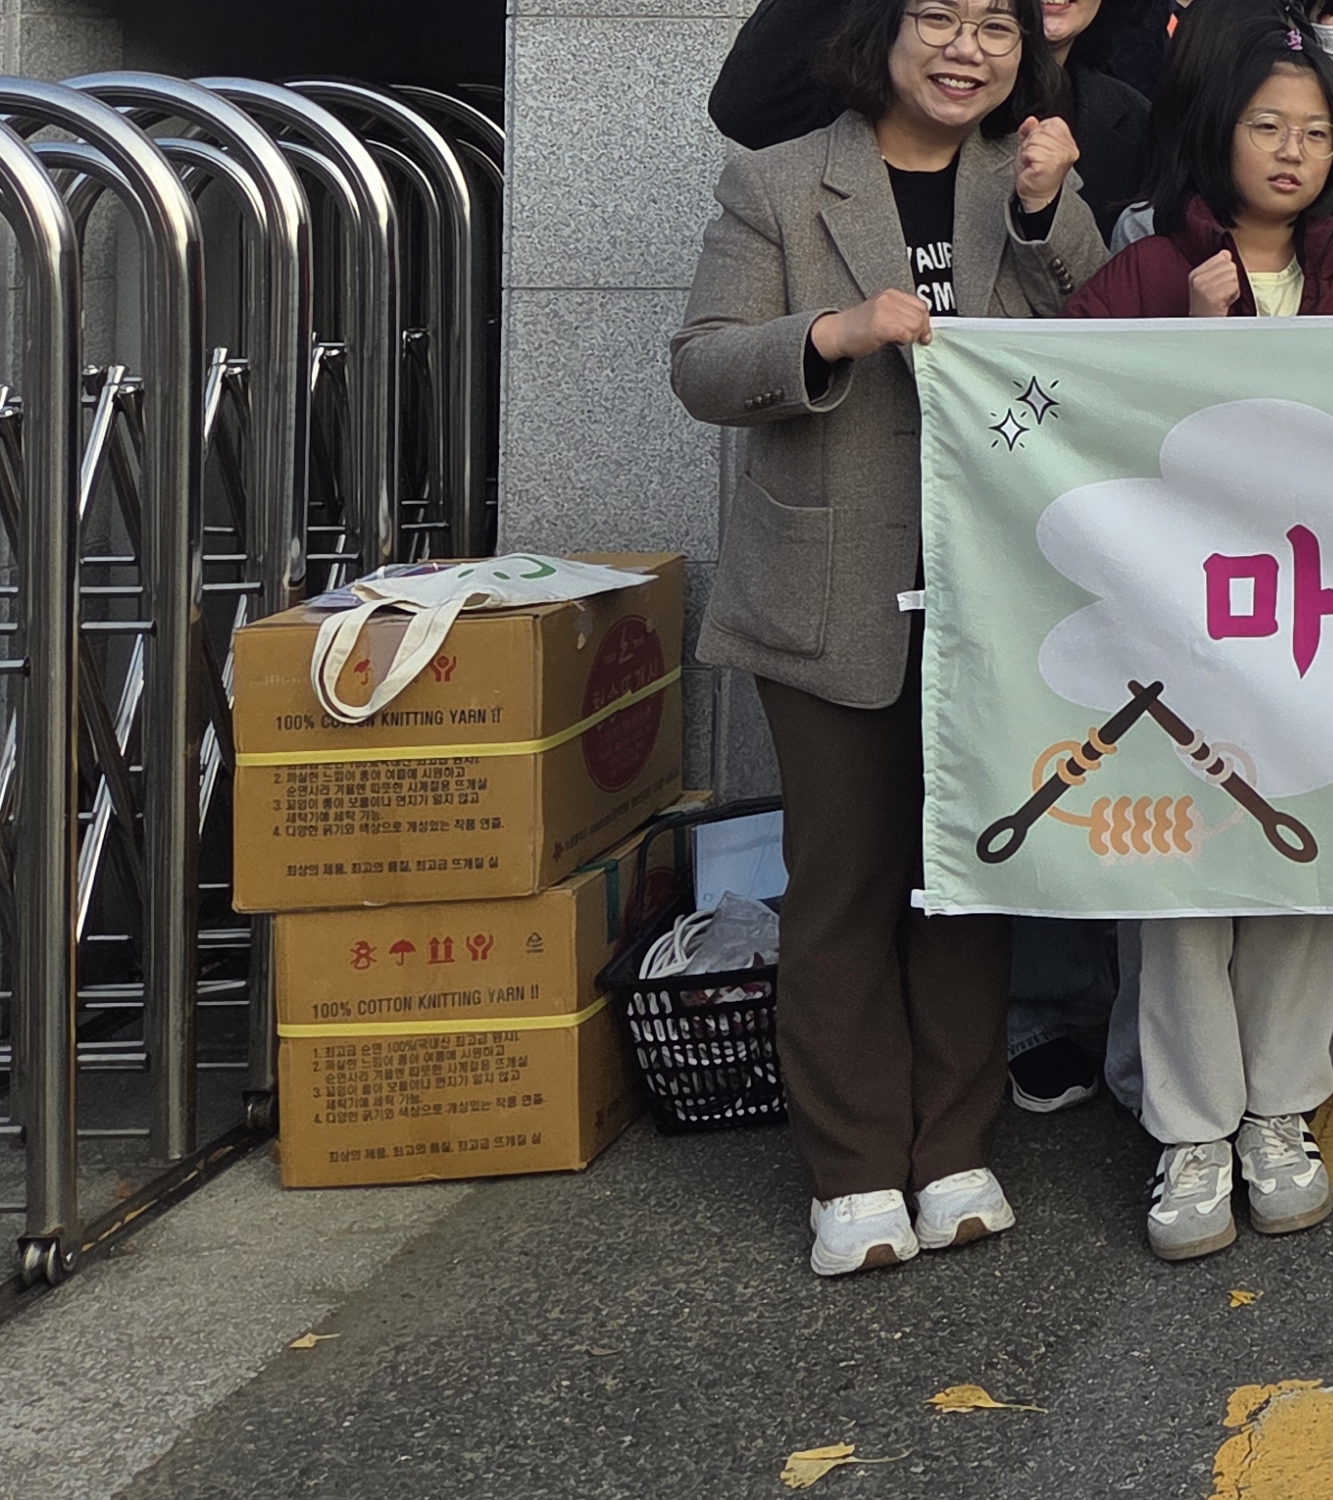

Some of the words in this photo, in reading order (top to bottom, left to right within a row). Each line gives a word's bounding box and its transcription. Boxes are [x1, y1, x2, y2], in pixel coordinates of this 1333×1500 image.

[276, 714, 315, 731] 100%
[321, 710, 375, 730] COON
[381, 709, 444, 728] KNITTING
[449, 706, 487, 725] YARN
[313, 1001, 352, 1019] 100%
[357, 996, 413, 1016] COTTON
[417, 989, 483, 1011] KNITTING
[487, 985, 525, 1004] YARN
